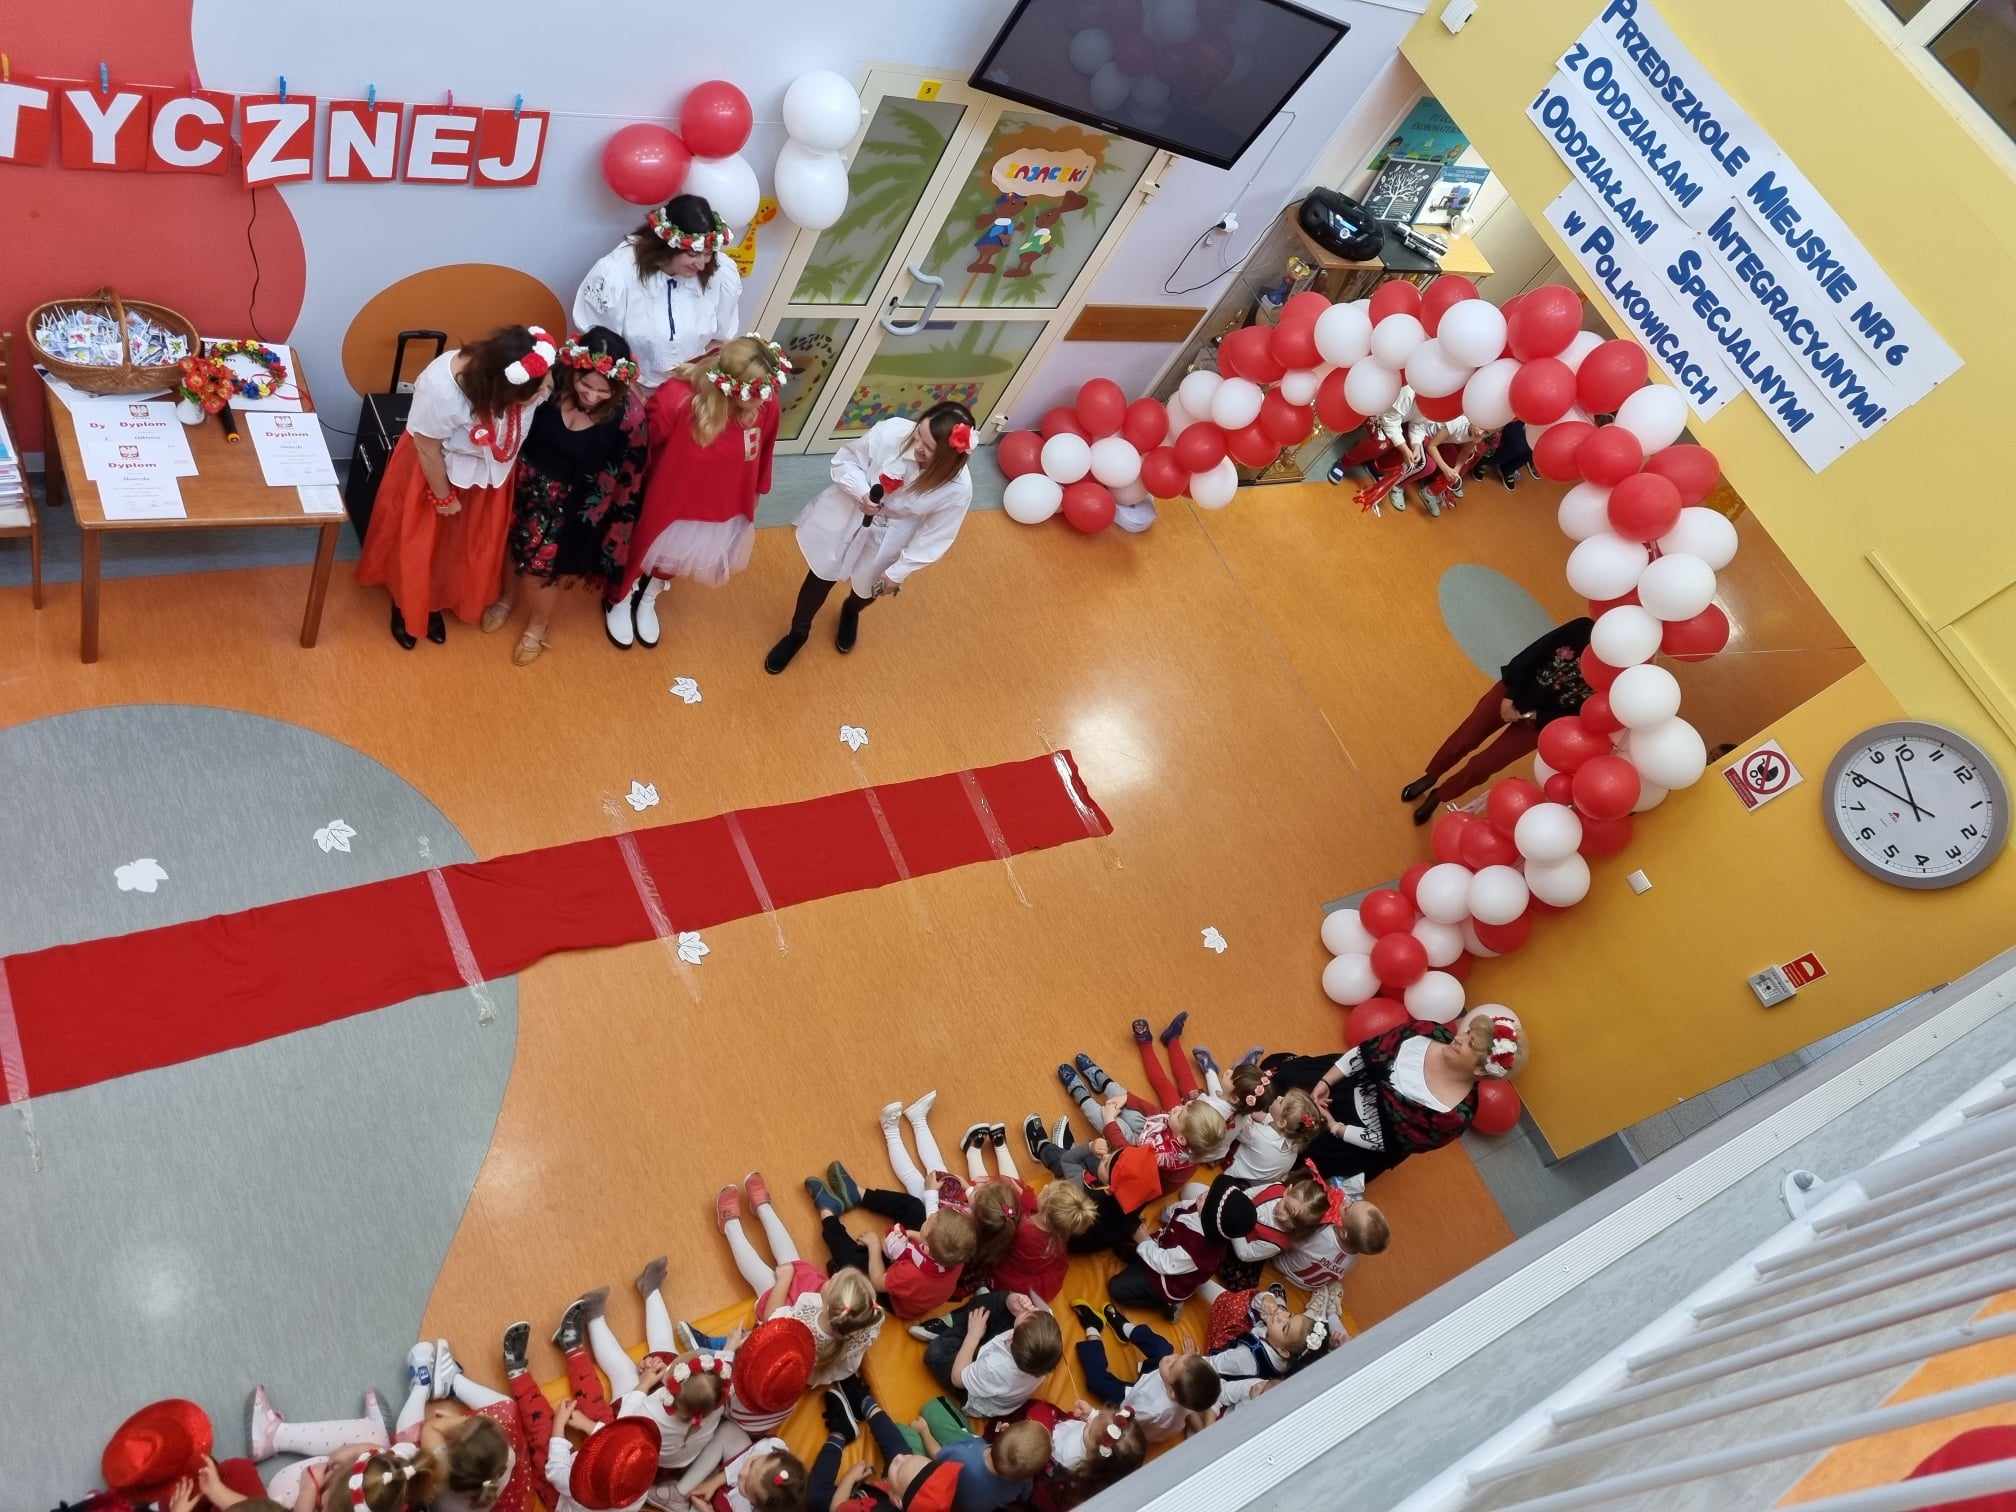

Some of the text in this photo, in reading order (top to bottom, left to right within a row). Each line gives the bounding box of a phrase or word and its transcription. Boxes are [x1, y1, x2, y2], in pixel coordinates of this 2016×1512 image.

[1601, 0, 1750, 177] PRZEDSZKOLE
[1747, 170, 1857, 303] MIEJSKIE
[1581, 225, 1718, 405] POLKOWICACH
[1707, 206, 1887, 428] INTEGRACYJNYMI
[1666, 249, 1814, 433] SPECJALNYMI
[1869, 750, 1886, 765] 9
[1895, 743, 1915, 763] 10
[1929, 749, 1945, 762] 11
[1852, 773, 1869, 788] 8
[1953, 764, 1974, 785] 12
[1849, 800, 1866, 813] 7
[1969, 800, 1984, 810] 1
[1860, 826, 1876, 841] 6
[1960, 824, 1978, 840] 2
[1883, 844, 1900, 859] 5
[1945, 845, 1962, 860] 3
[1914, 854, 1931, 867] 4
